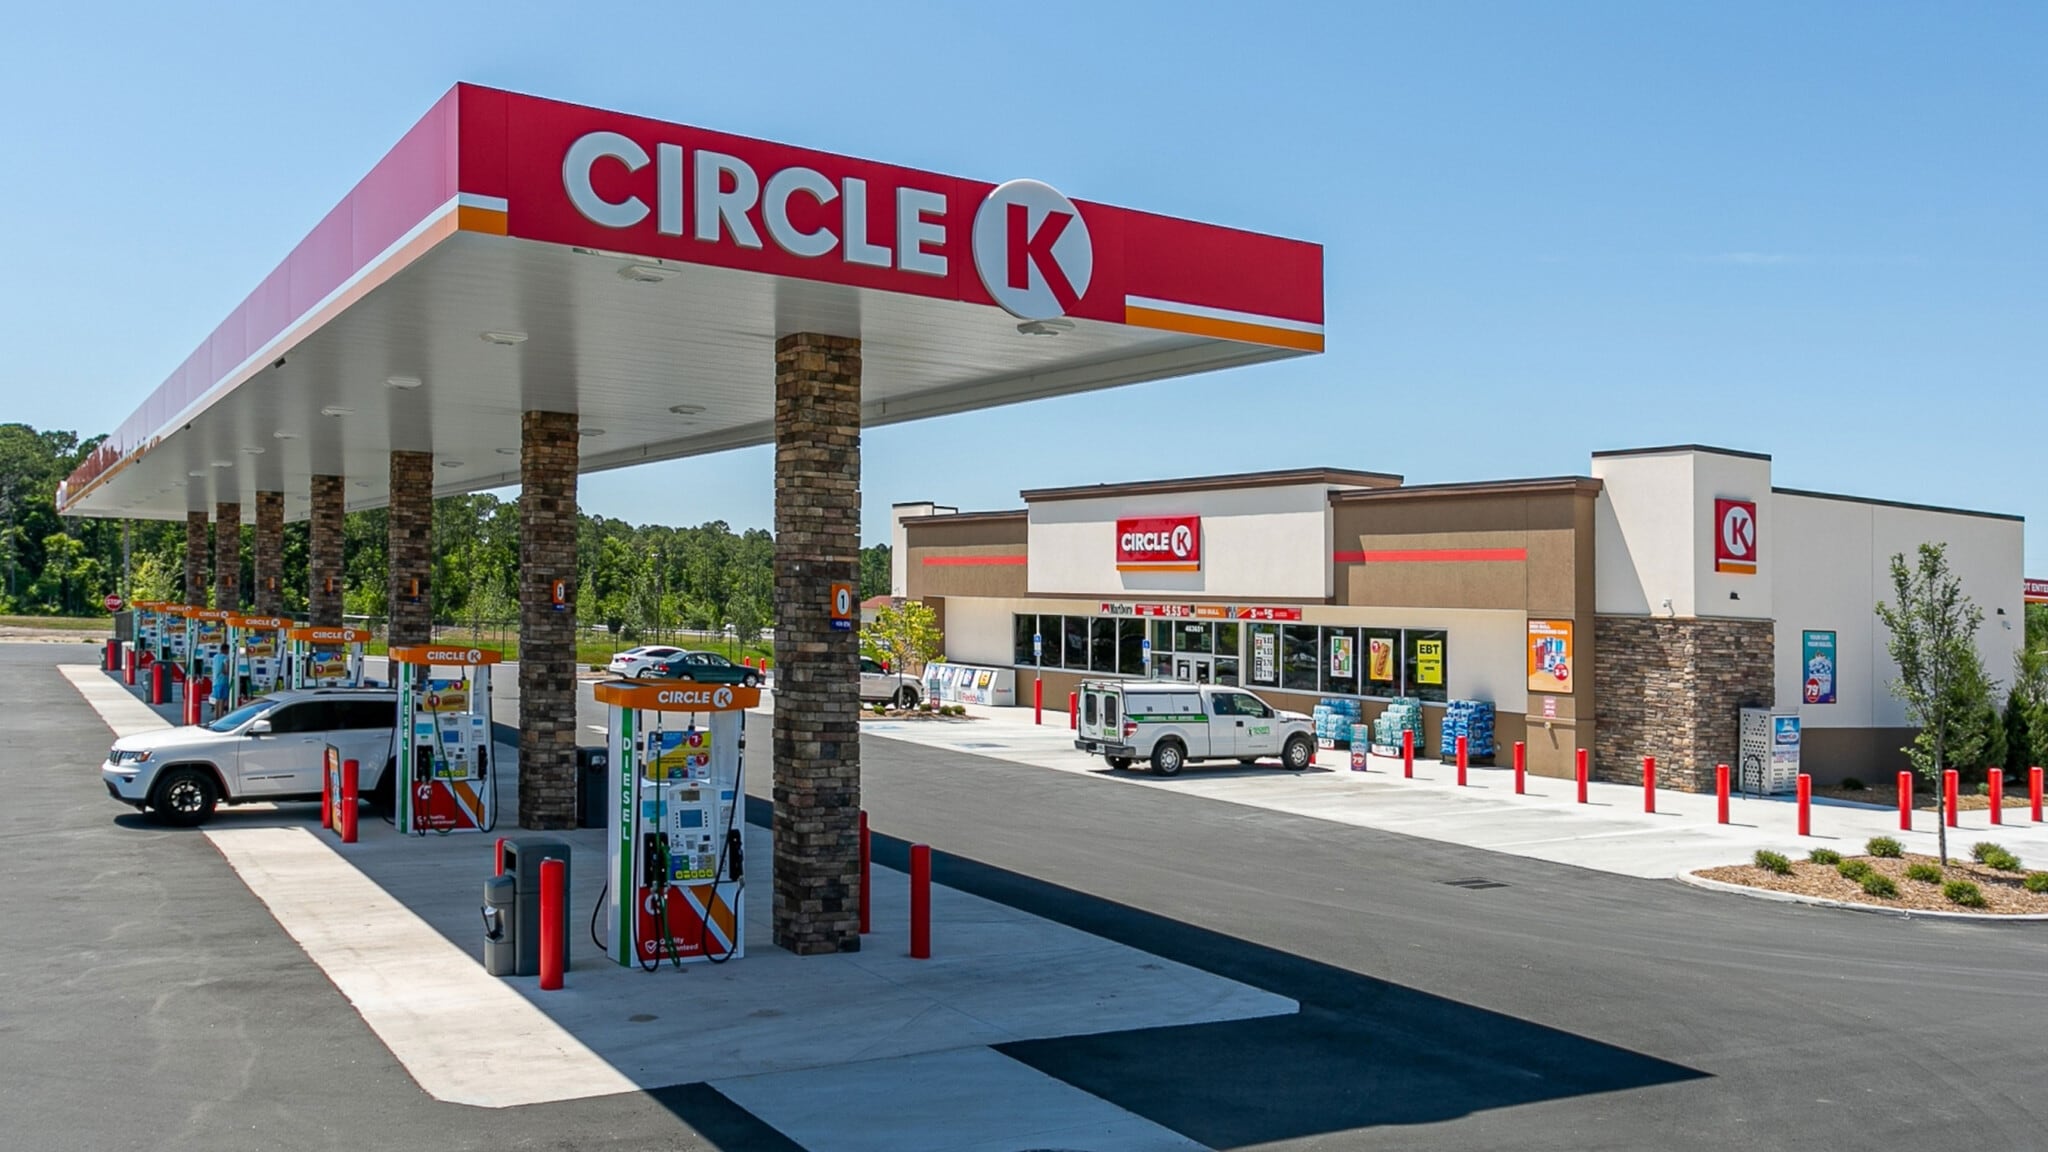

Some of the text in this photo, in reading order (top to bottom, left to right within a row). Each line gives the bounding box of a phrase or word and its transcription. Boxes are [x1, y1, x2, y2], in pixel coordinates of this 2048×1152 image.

[562, 130, 1083, 317] CIRCLE K
[1121, 532, 1170, 552] CIRCLE
[427, 651, 465, 660] CIRCLE
[1420, 644, 1440, 654] EBT
[658, 690, 710, 704] CIRCLE
[622, 738, 632, 840] DIESEL
